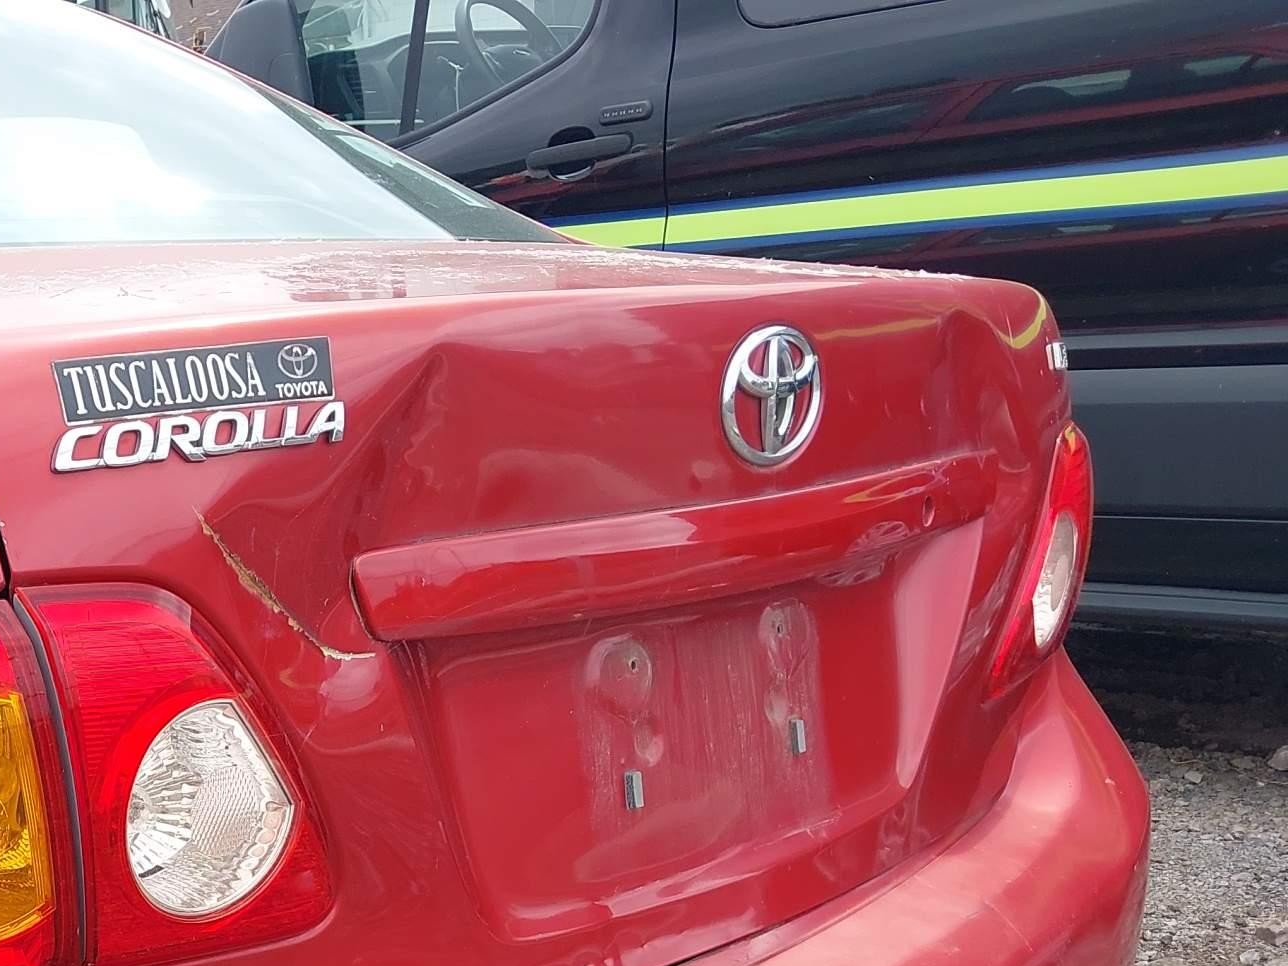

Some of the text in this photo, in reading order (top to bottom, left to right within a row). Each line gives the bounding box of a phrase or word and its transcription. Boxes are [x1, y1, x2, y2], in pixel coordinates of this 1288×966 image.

[63, 351, 266, 415] TUSCALOOSA
[275, 381, 328, 397] TOYOTA
[51, 401, 345, 473] COROLLA
